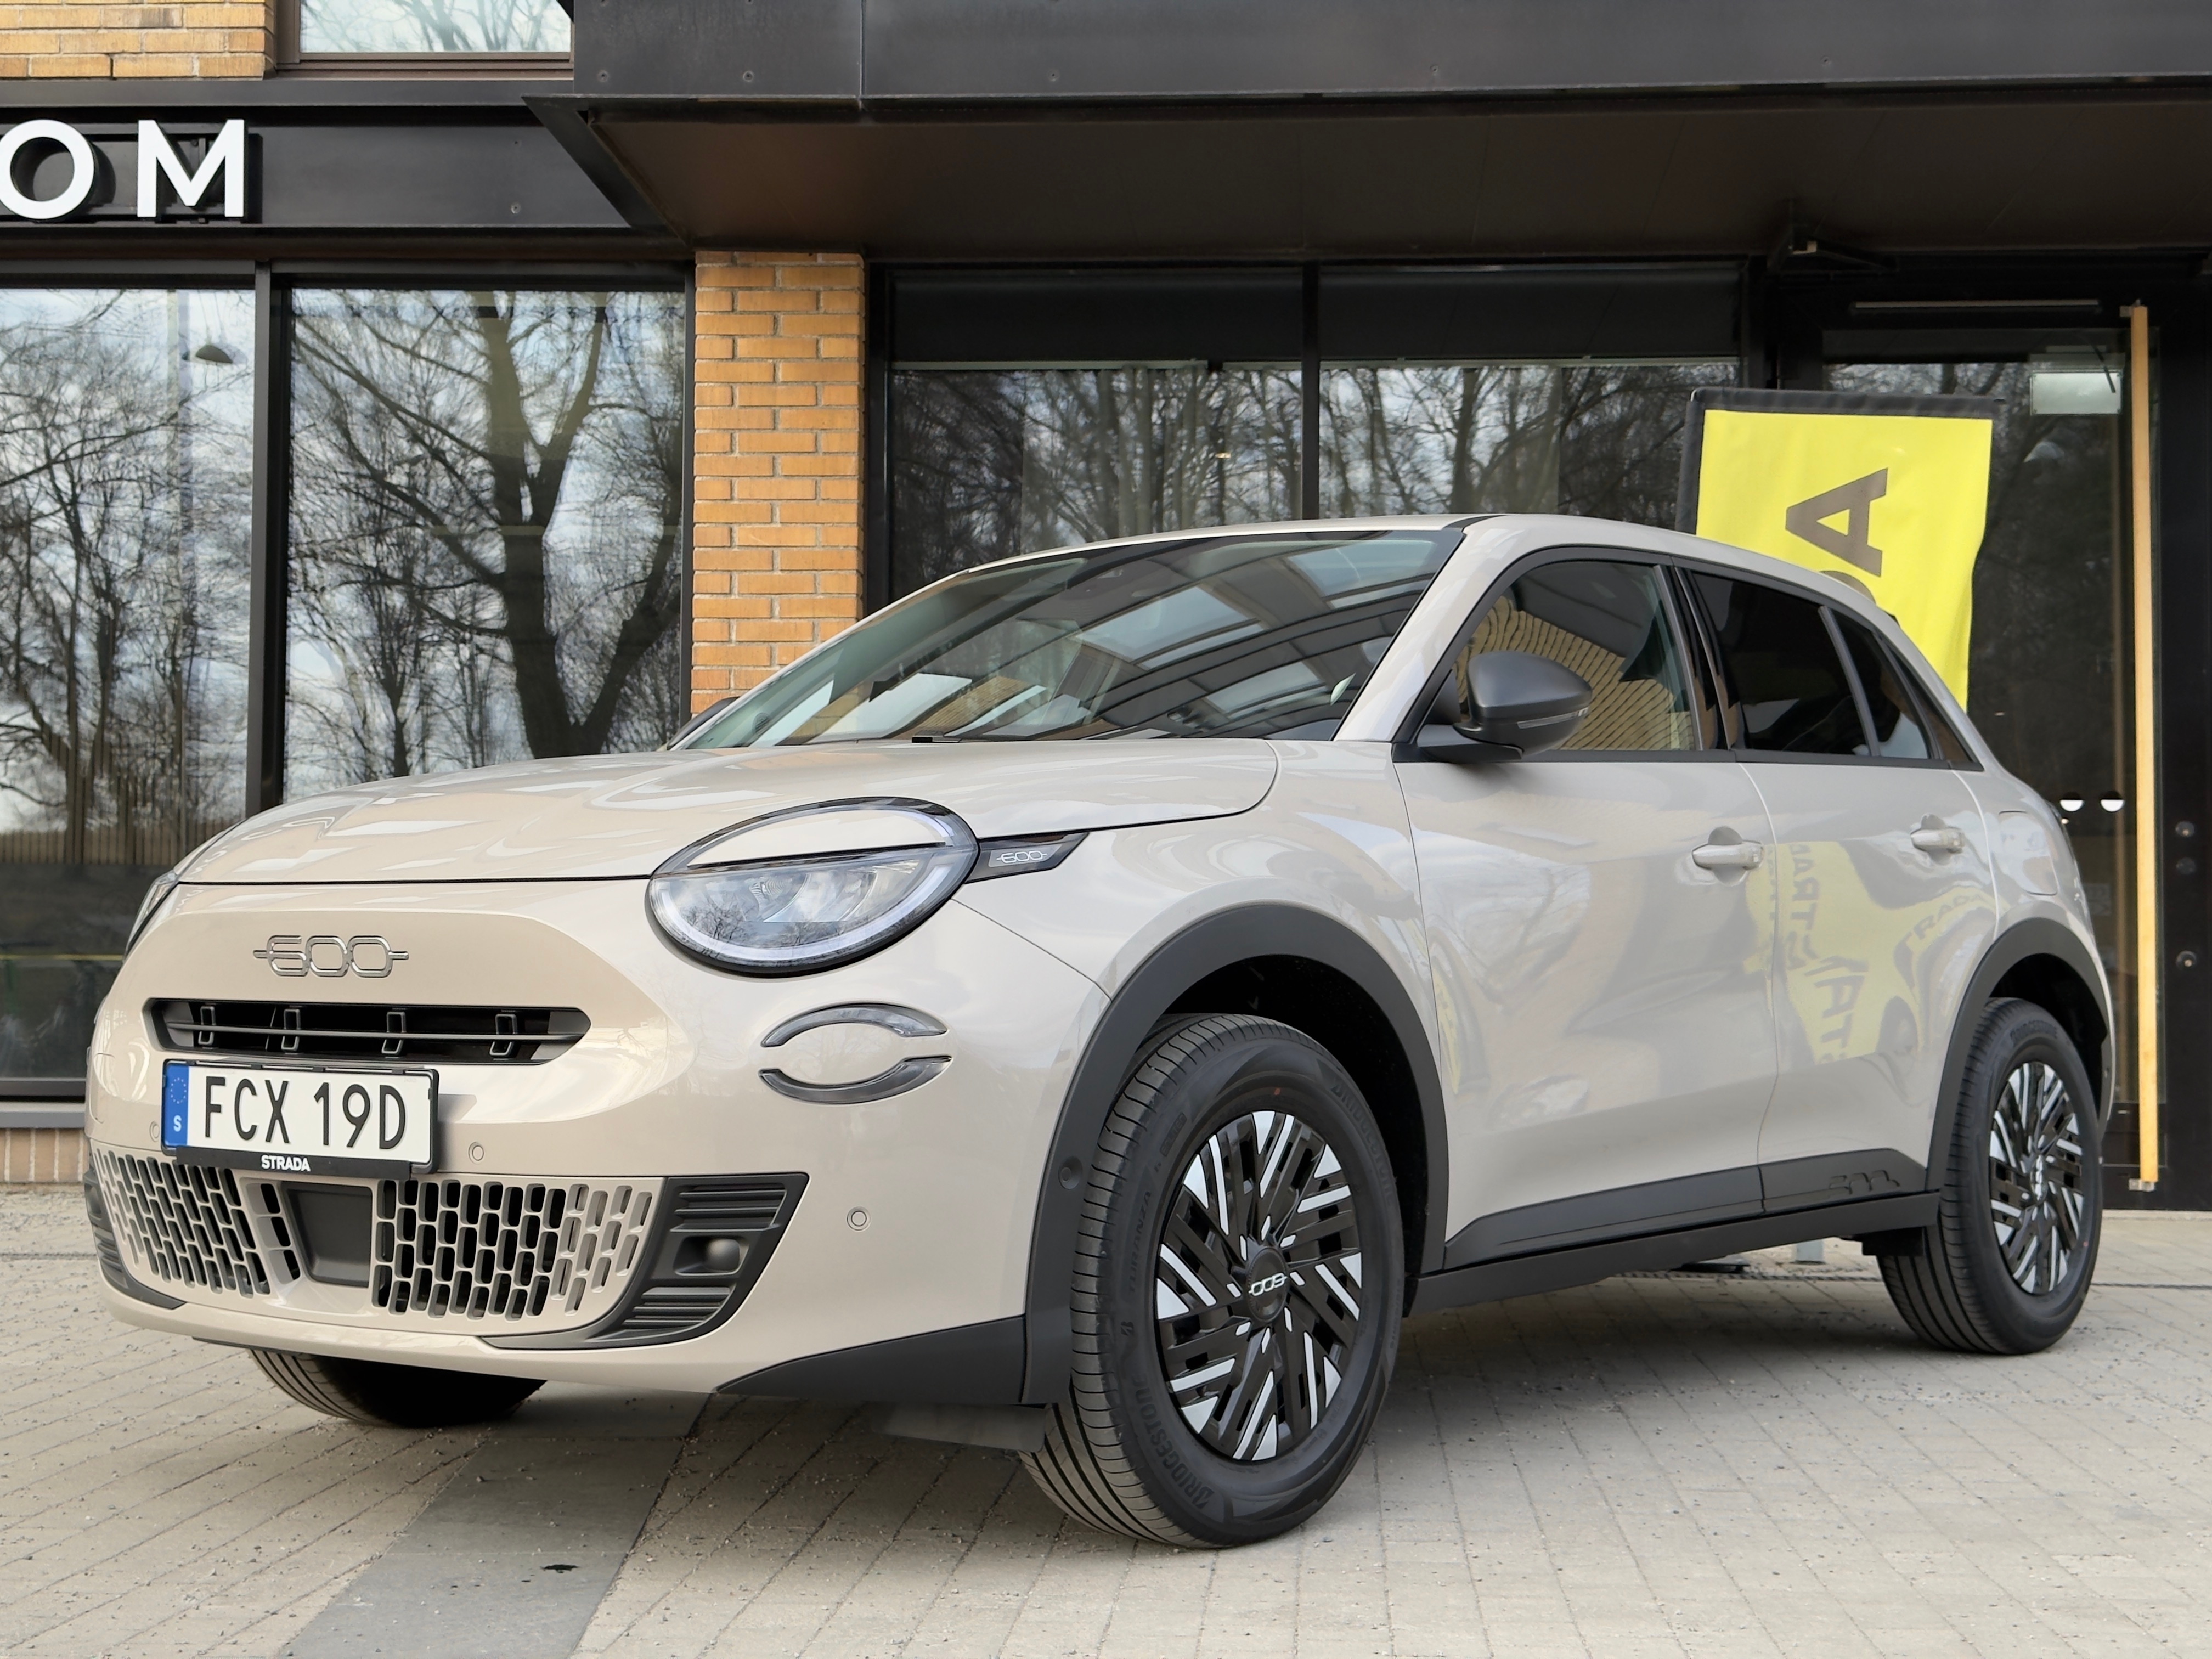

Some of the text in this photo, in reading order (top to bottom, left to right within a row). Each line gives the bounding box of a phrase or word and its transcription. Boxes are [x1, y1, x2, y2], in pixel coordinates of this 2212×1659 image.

[0, 119, 245, 219] OM
[1785, 467, 1888, 605] A
[1000, 850, 1043, 864] 600
[266, 935, 394, 978] 600
[173, 1115, 182, 1132] S
[205, 1075, 406, 1149] FCX 19D
[261, 1155, 311, 1172] STRADA
[1128, 1190, 1152, 1295] TURANZA
[1250, 1272, 1286, 1297] 600
[1131, 1372, 1215, 1509] BRIDGESTONE
